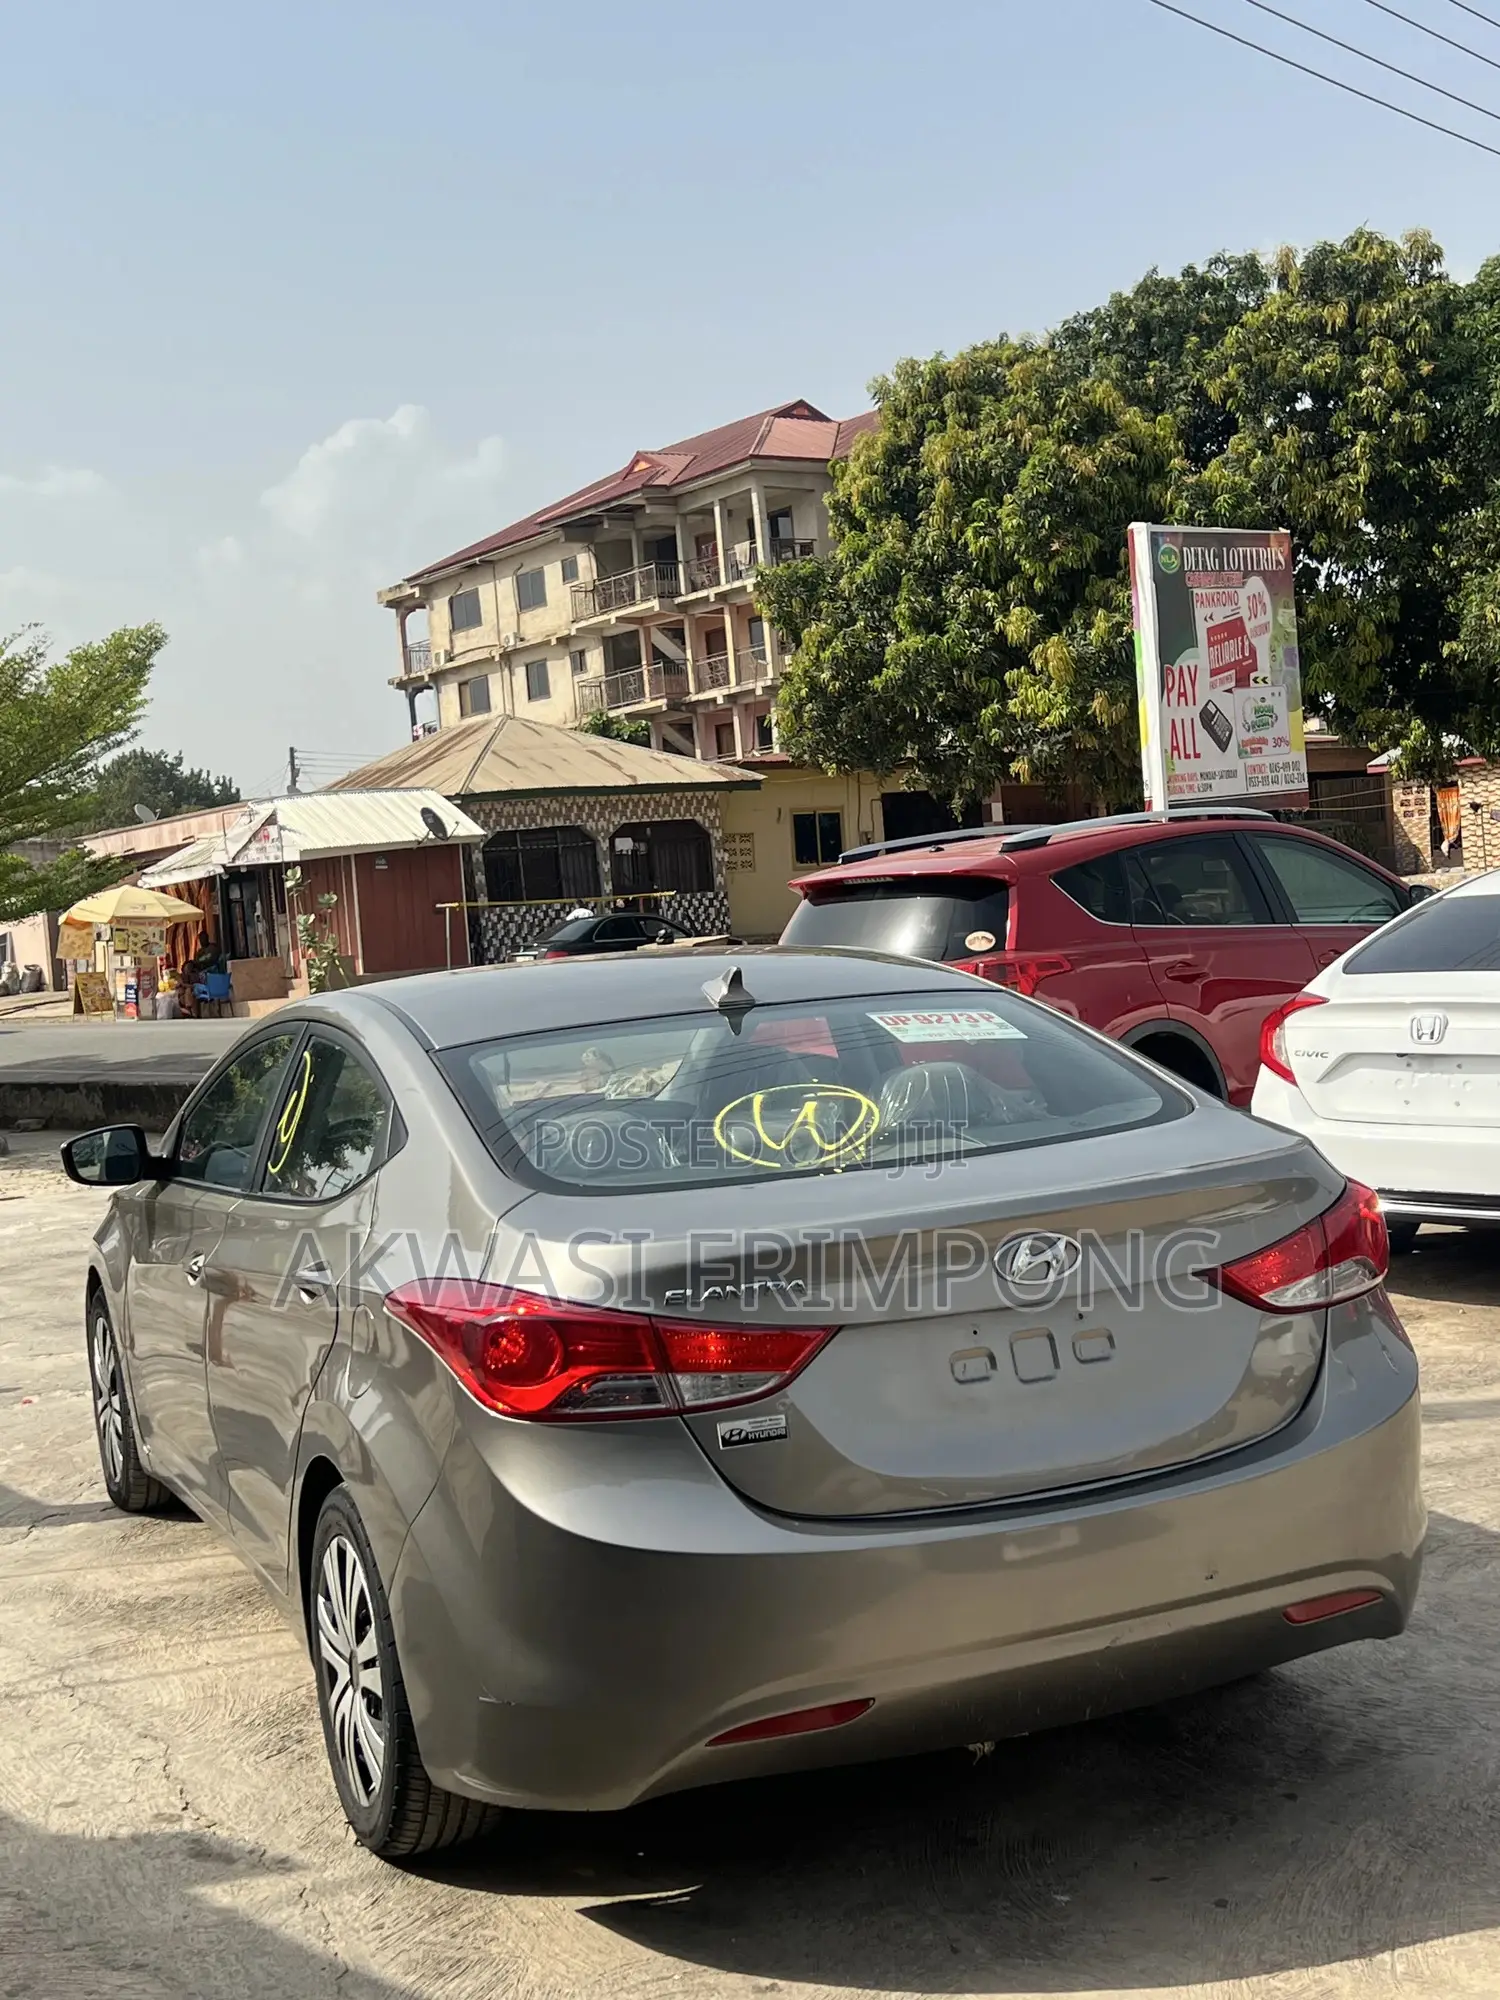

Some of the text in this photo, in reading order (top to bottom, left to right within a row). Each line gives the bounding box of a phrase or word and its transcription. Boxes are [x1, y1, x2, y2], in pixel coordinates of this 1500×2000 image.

[1183, 546, 1286, 571] DEFAG LOTTERIES
[1195, 590, 1239, 608] PANKRONO
[1247, 591, 1267, 621] 30%
[1209, 637, 1243, 669] RELIABLE
[1165, 665, 1198, 707] PAY
[1170, 718, 1201, 760] ALL
[1272, 735, 1290, 748] 30%
[877, 1015, 912, 1026] DP
[1294, 1049, 1329, 1059] CIVIC
[663, 1279, 808, 1306] ELANTRA
[748, 1427, 786, 1440] HYUNDAI
